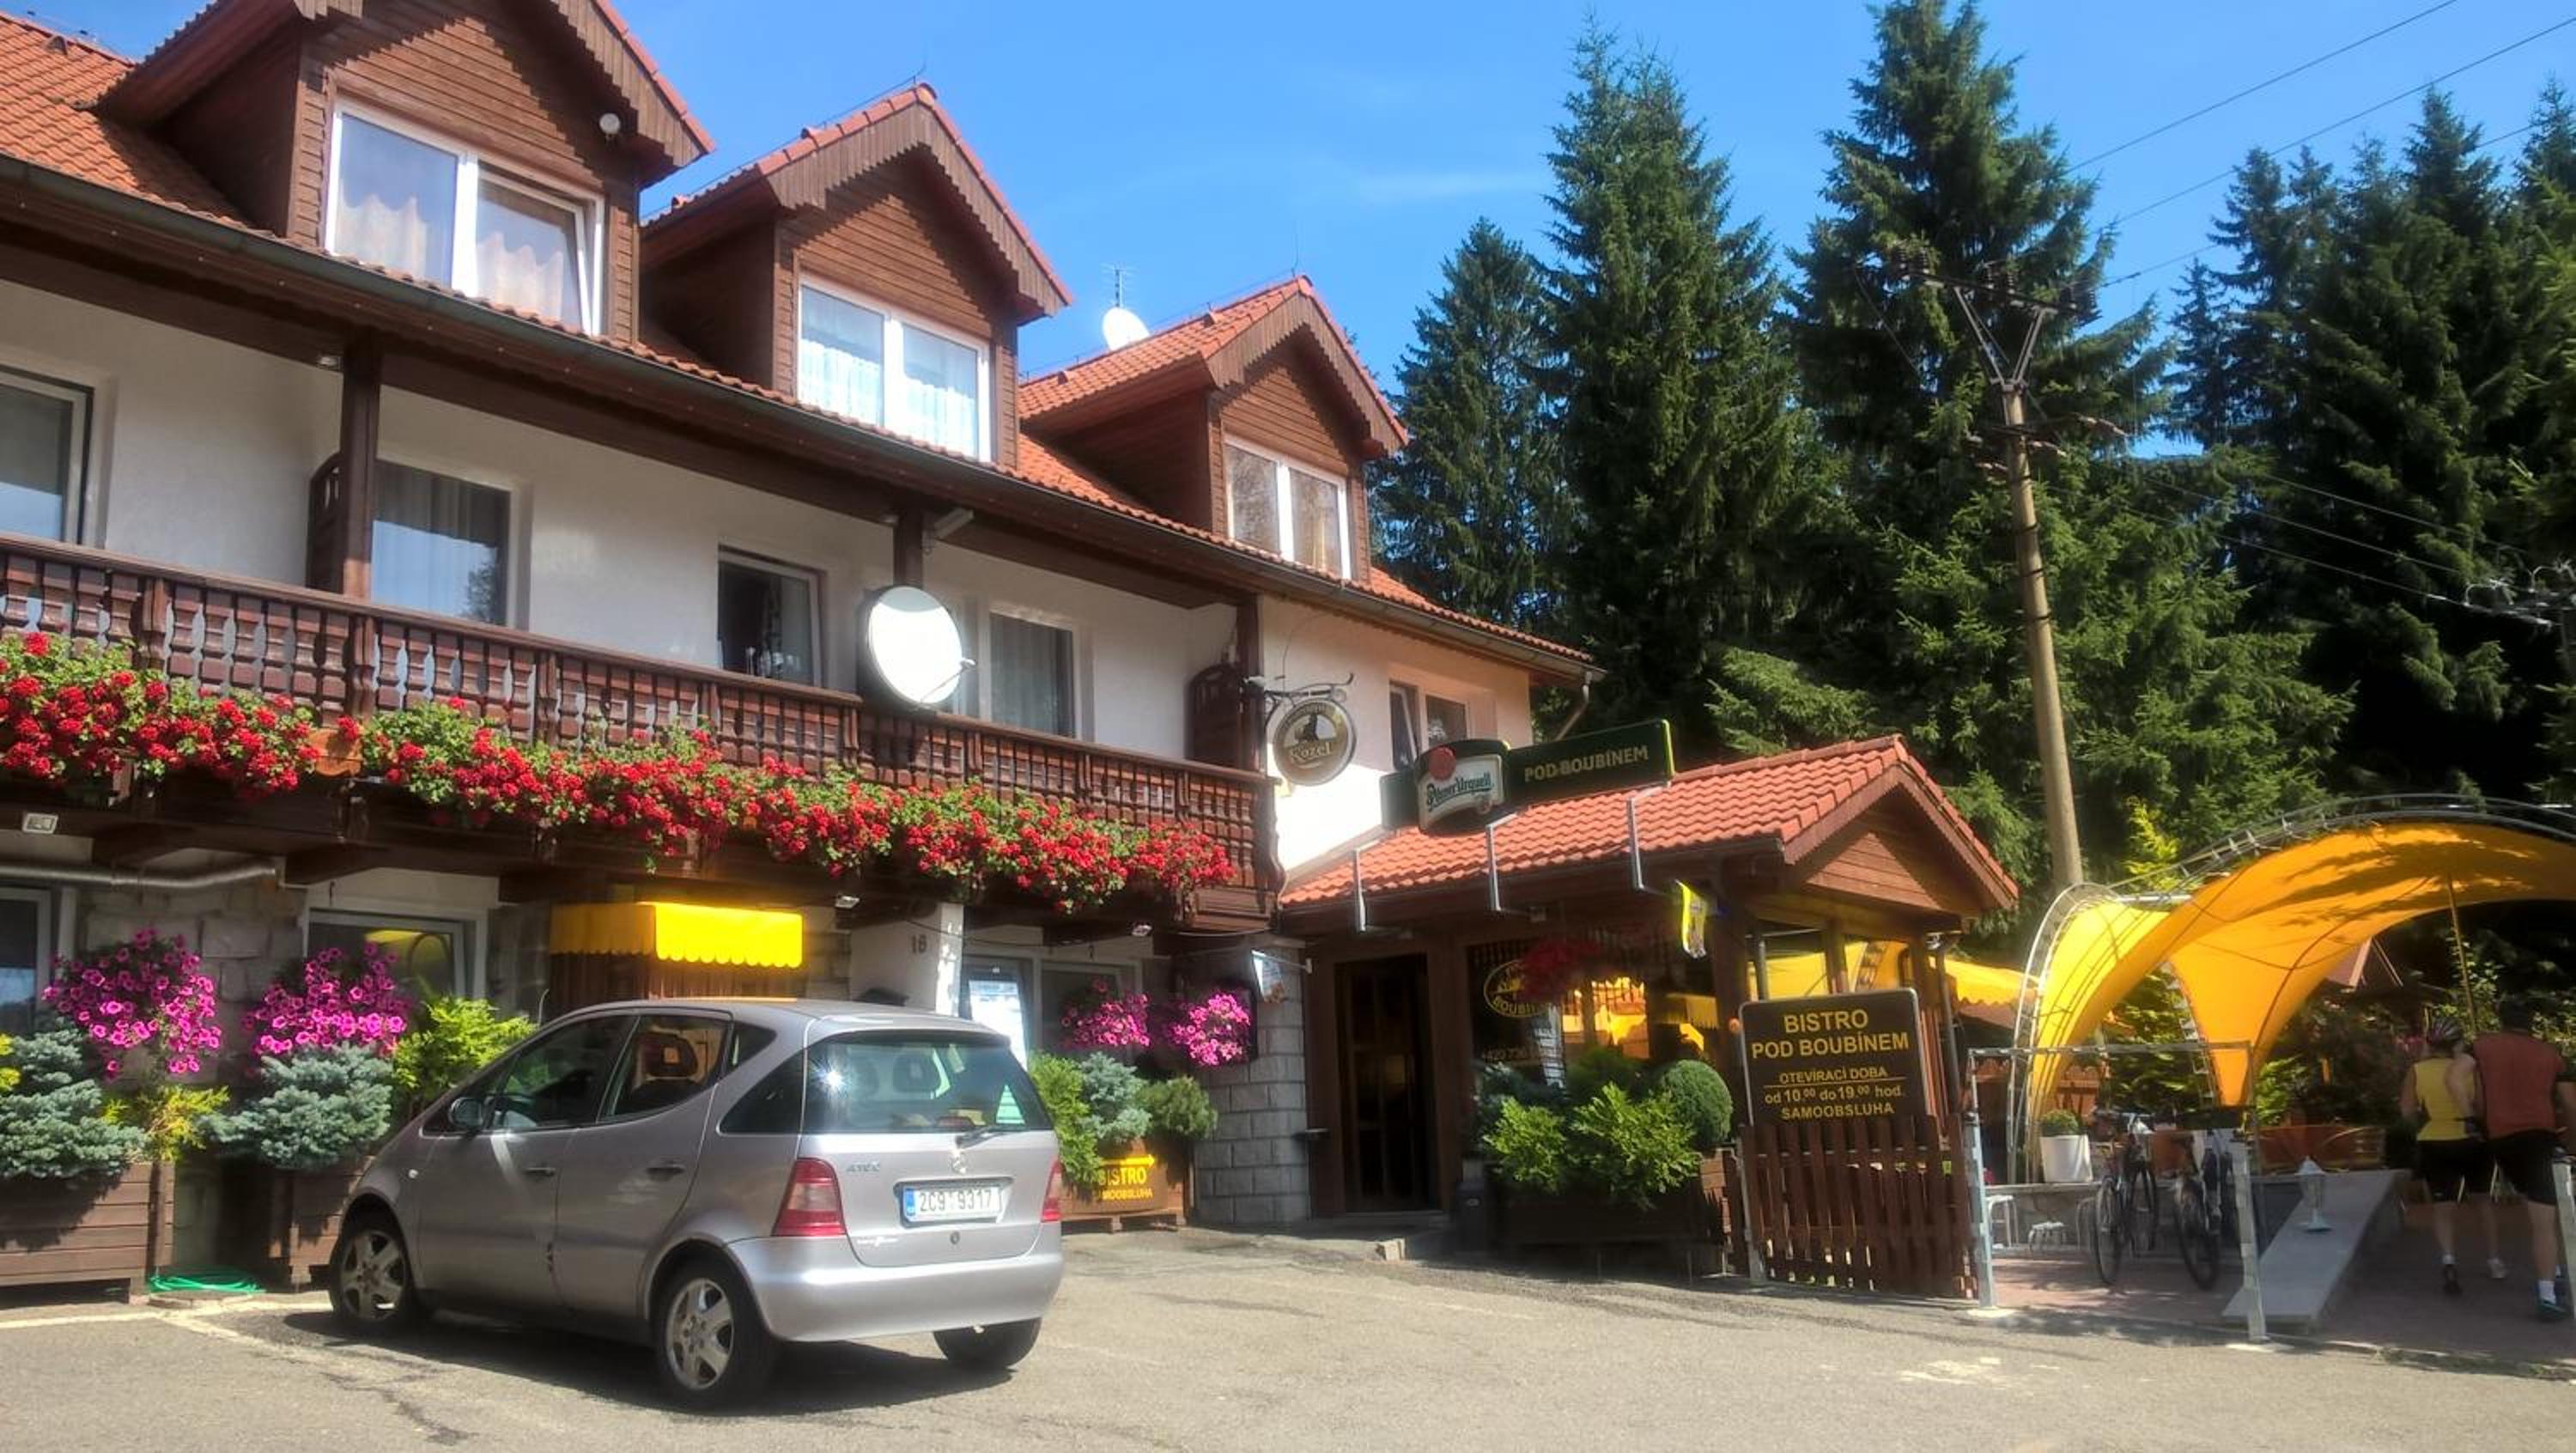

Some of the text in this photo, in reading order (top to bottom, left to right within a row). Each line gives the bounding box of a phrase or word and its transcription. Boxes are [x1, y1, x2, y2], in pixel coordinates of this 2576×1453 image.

[1524, 745, 1649, 782] POD BOUBÍNEM
[1783, 1009, 1868, 1033] BISTRO
[1752, 1031, 1909, 1059] POD BOUBÍNEM
[1850, 1067, 1887, 1079] DOBA
[1765, 1092, 1782, 1103] od
[1819, 1090, 1837, 1100] do
[1782, 1103, 1895, 1119] SAMOOBSLUHA
[920, 1189, 991, 1212] 2C9 9317
